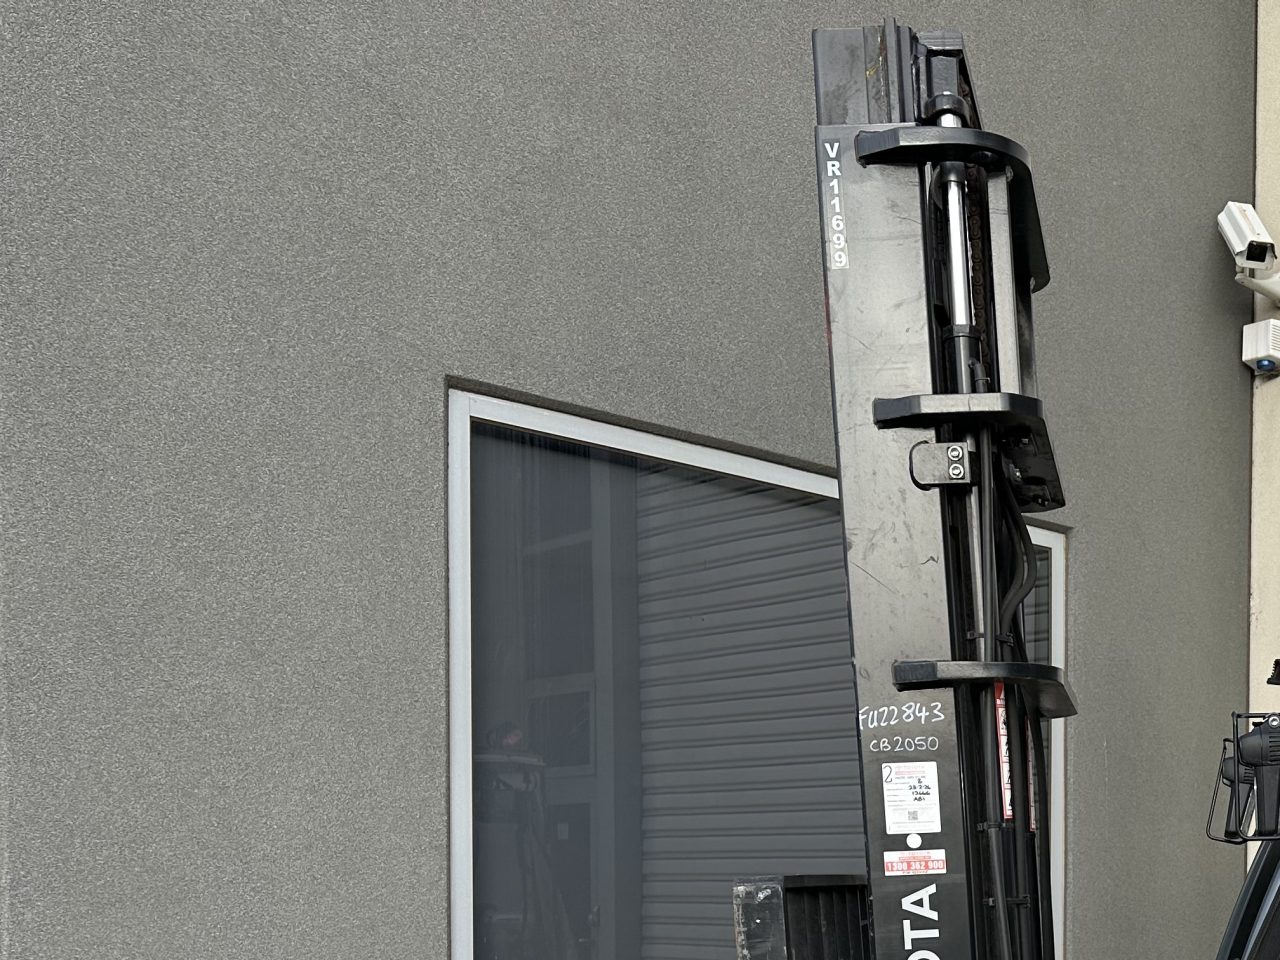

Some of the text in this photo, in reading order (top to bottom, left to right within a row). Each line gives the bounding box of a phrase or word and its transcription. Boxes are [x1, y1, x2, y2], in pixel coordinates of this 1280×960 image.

[824, 142, 847, 267] VR11699
[869, 736, 939, 752] CB2050
[883, 765, 893, 783] 2
[887, 860, 944, 871] 1300 362 900
